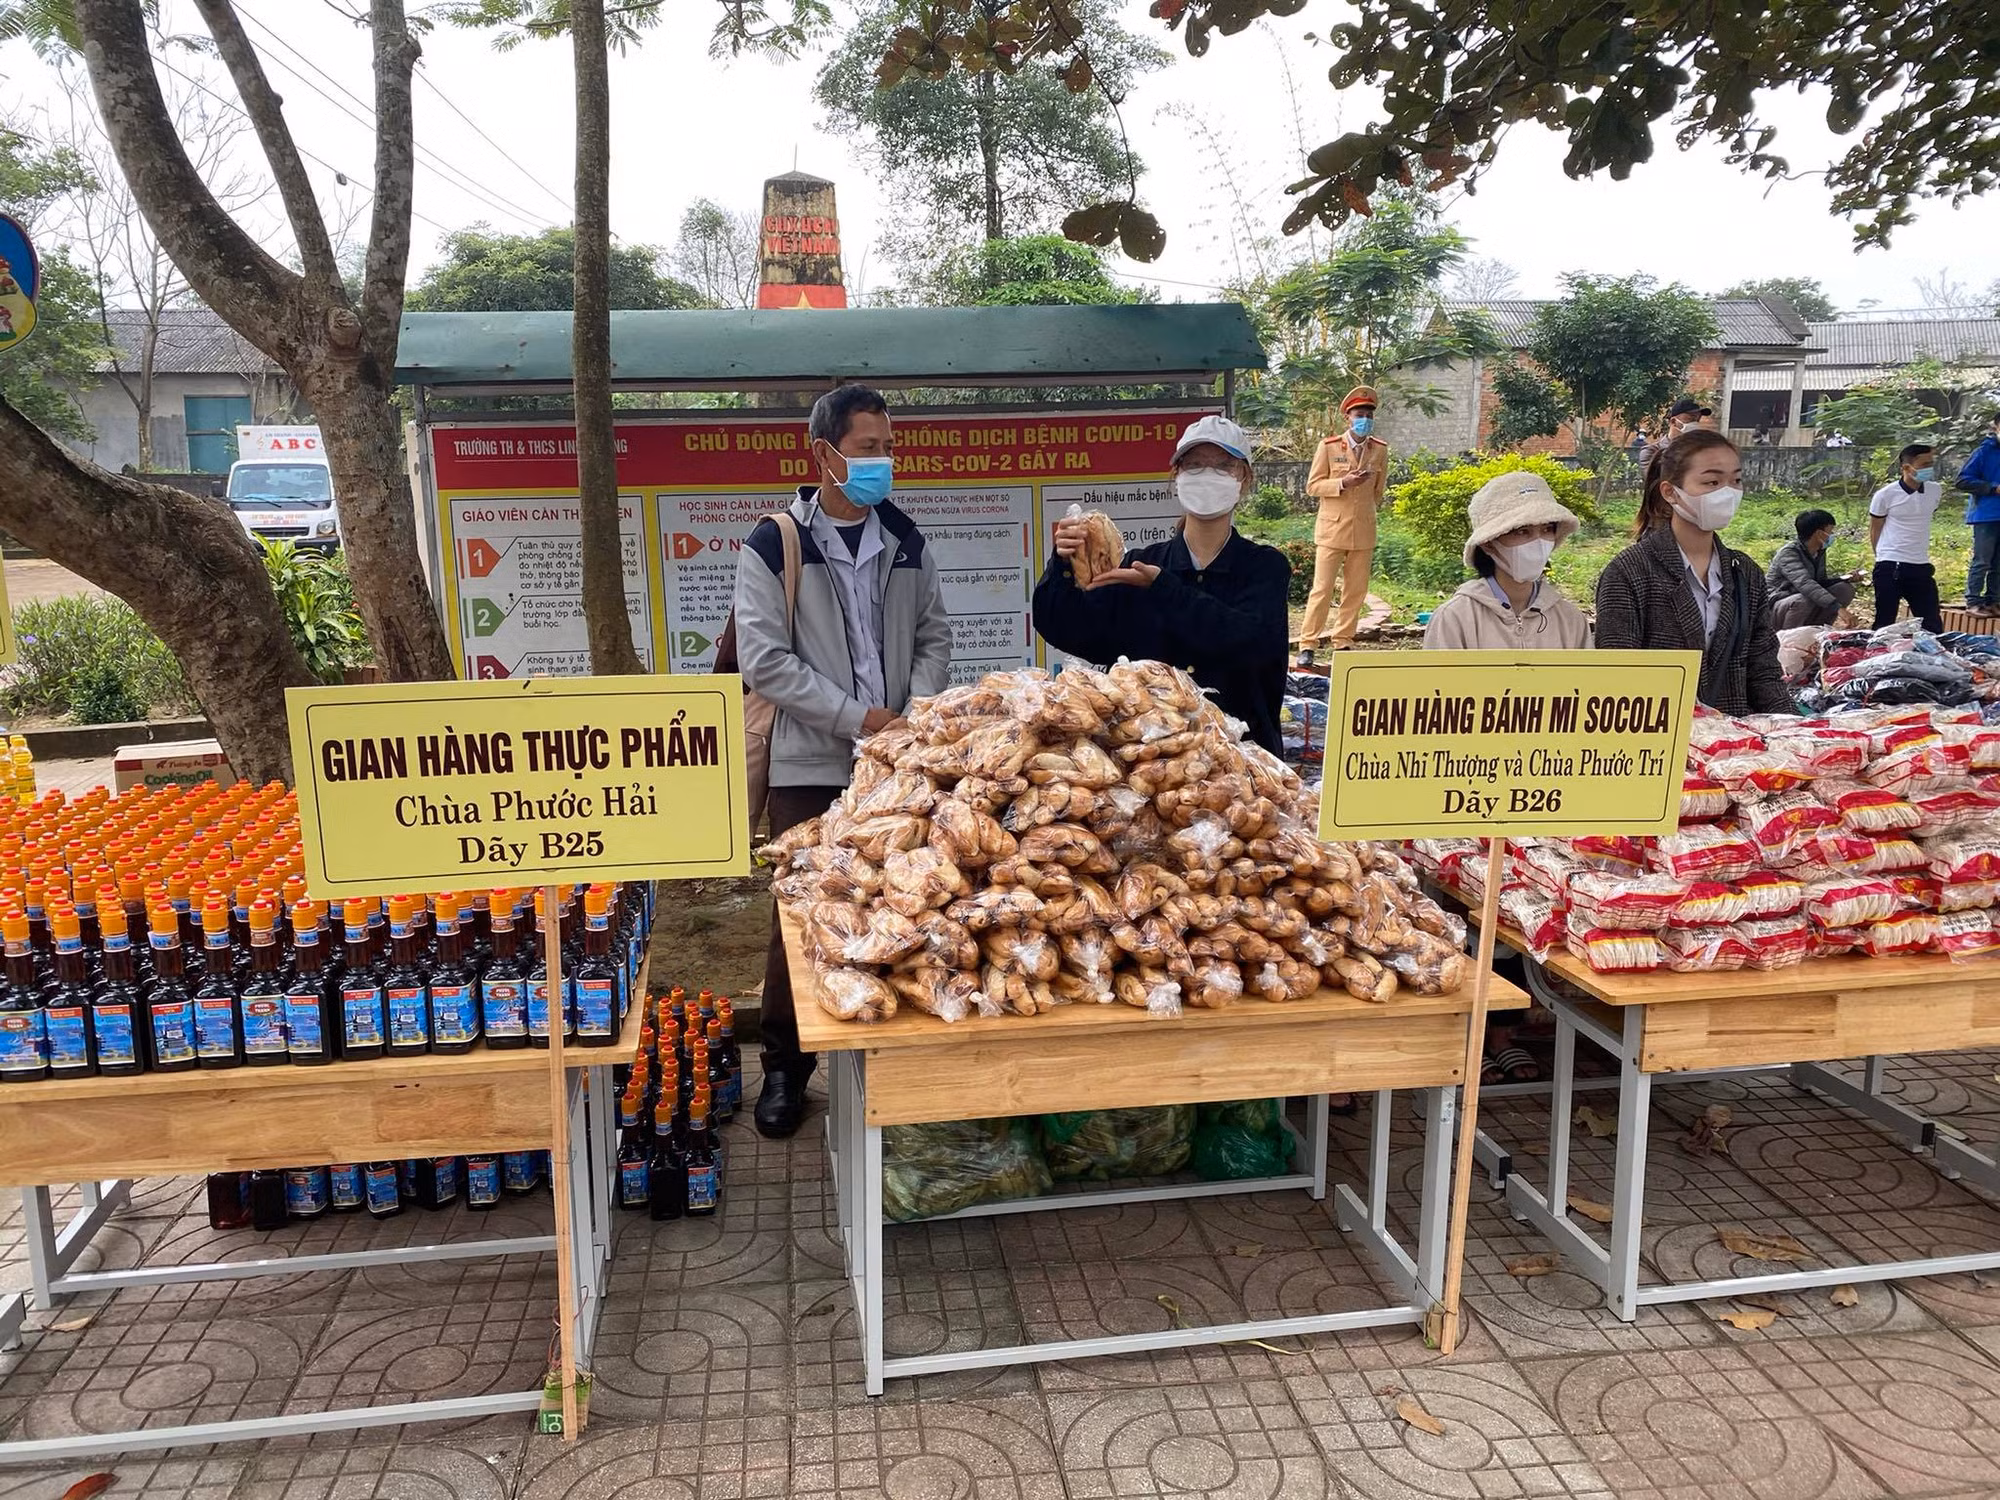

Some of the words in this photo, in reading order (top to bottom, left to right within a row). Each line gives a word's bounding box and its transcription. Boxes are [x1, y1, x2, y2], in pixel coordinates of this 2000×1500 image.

[454, 437, 497, 456] TRƯỜNG
[500, 440, 513, 455] TH
[517, 440, 525, 455] &
[527, 439, 556, 455] THCS
[558, 439, 577, 454] LIN
[685, 428, 729, 451] CHỦ
[736, 430, 796, 454] ĐỘNG
[892, 424, 961, 447] CHỐNG
[969, 429, 1017, 450] DỊCH
[1024, 424, 1079, 448] BỆNH
[1085, 424, 1177, 443] COVID-19
[780, 459, 808, 476] DO
[893, 454, 1012, 472] SARS-COV-2
[1019, 450, 1058, 470] GÂY
[1065, 452, 1091, 469] RA
[1084, 490, 1102, 503] Dấu
[1105, 491, 1125, 504] hiệu
[1127, 488, 1147, 501] mắc
[1149, 490, 1172, 503] bệnh
[462, 508, 495, 522] GIÁO
[498, 507, 528, 521] VIÊN
[562, 508, 580, 520] TH
[679, 502, 702, 514] HỌC
[704, 501, 727, 510] SINH
[1123, 531, 1136, 541] ao
[1169, 526, 1176, 538] 3
[558, 542, 573, 550] quy
[678, 538, 688, 555] 1
[709, 536, 724, 551] Ở
[473, 549, 483, 567] 1
[699, 574, 725, 582] miệng
[720, 584, 735, 592] miệ
[477, 608, 490, 627] 2
[684, 636, 697, 652] 2
[483, 665, 495, 679] 3
[571, 665, 584, 673] gia
[1352, 698, 1408, 736] GIAN
[1412, 689, 1475, 735] HÀNG
[1480, 688, 1541, 734] BÁNH
[1549, 688, 1580, 733] MÌ
[1584, 696, 1670, 734] SOCOLA
[322, 735, 408, 782] GIAN
[417, 726, 513, 777] HÀNG
[522, 725, 611, 780] THỰC
[621, 709, 719, 769] PHẨM
[1346, 752, 1391, 781] Chùa
[1396, 751, 1430, 779] Nhĩ
[1433, 750, 1500, 785] Thượng
[1505, 751, 1523, 777] và
[1529, 749, 1573, 777] Chùa
[1579, 749, 1634, 777] Phước
[1639, 749, 1665, 776] Trí
[395, 794, 482, 827] Chùa
[490, 788, 593, 823] Phước
[603, 783, 658, 817] Hải
[1442, 789, 1500, 819] Dãy
[1507, 789, 1562, 813] B26
[459, 837, 528, 867] Dãy
[539, 831, 605, 859] B25
